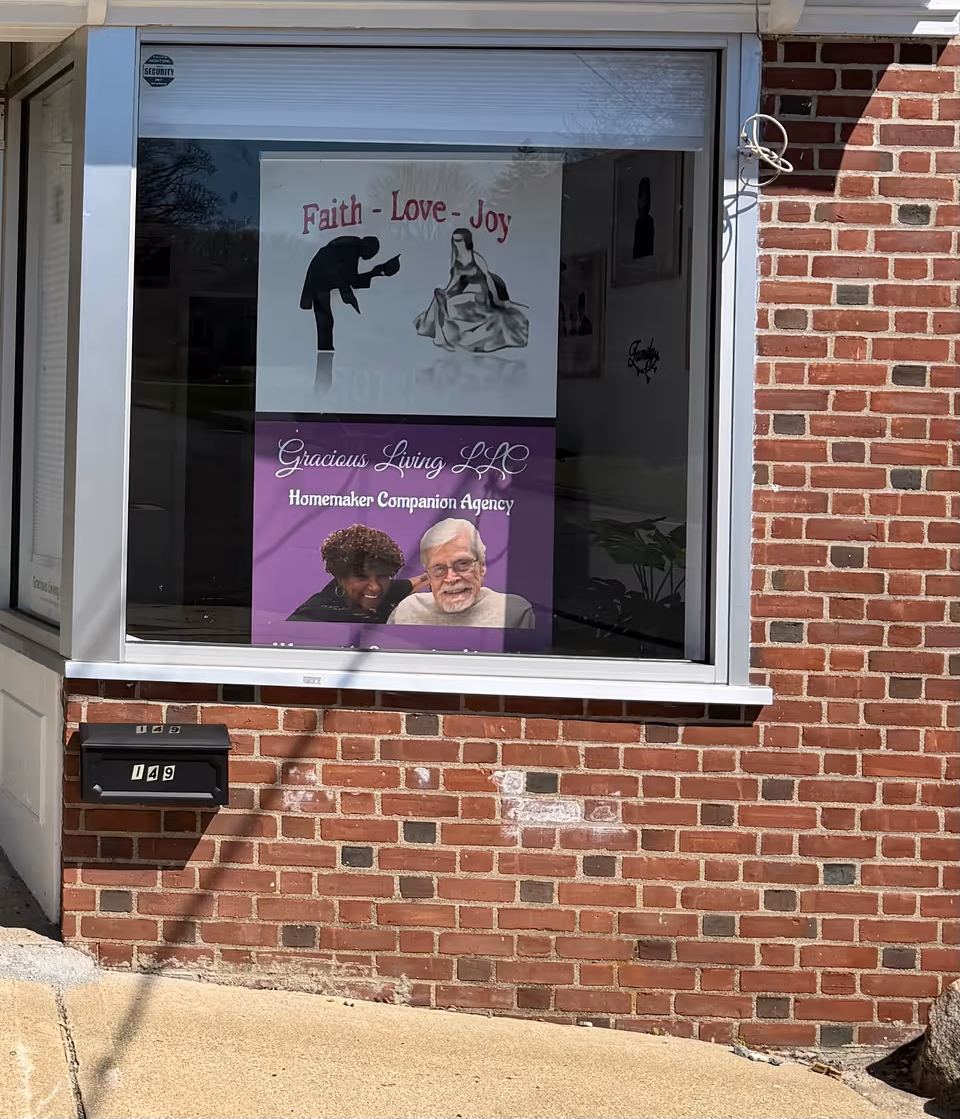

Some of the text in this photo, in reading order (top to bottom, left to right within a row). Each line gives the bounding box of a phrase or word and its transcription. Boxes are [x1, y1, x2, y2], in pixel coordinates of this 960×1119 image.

[144, 67, 175, 76] SECURITY
[302, 194, 362, 235] Faith
[391, 190, 447, 223] Love
[470, 198, 512, 244] Joy
[275, 438, 530, 481] Gracious Living LLC
[289, 488, 514, 517] Homemaker Companion Agency
[133, 764, 175, 781] 149
